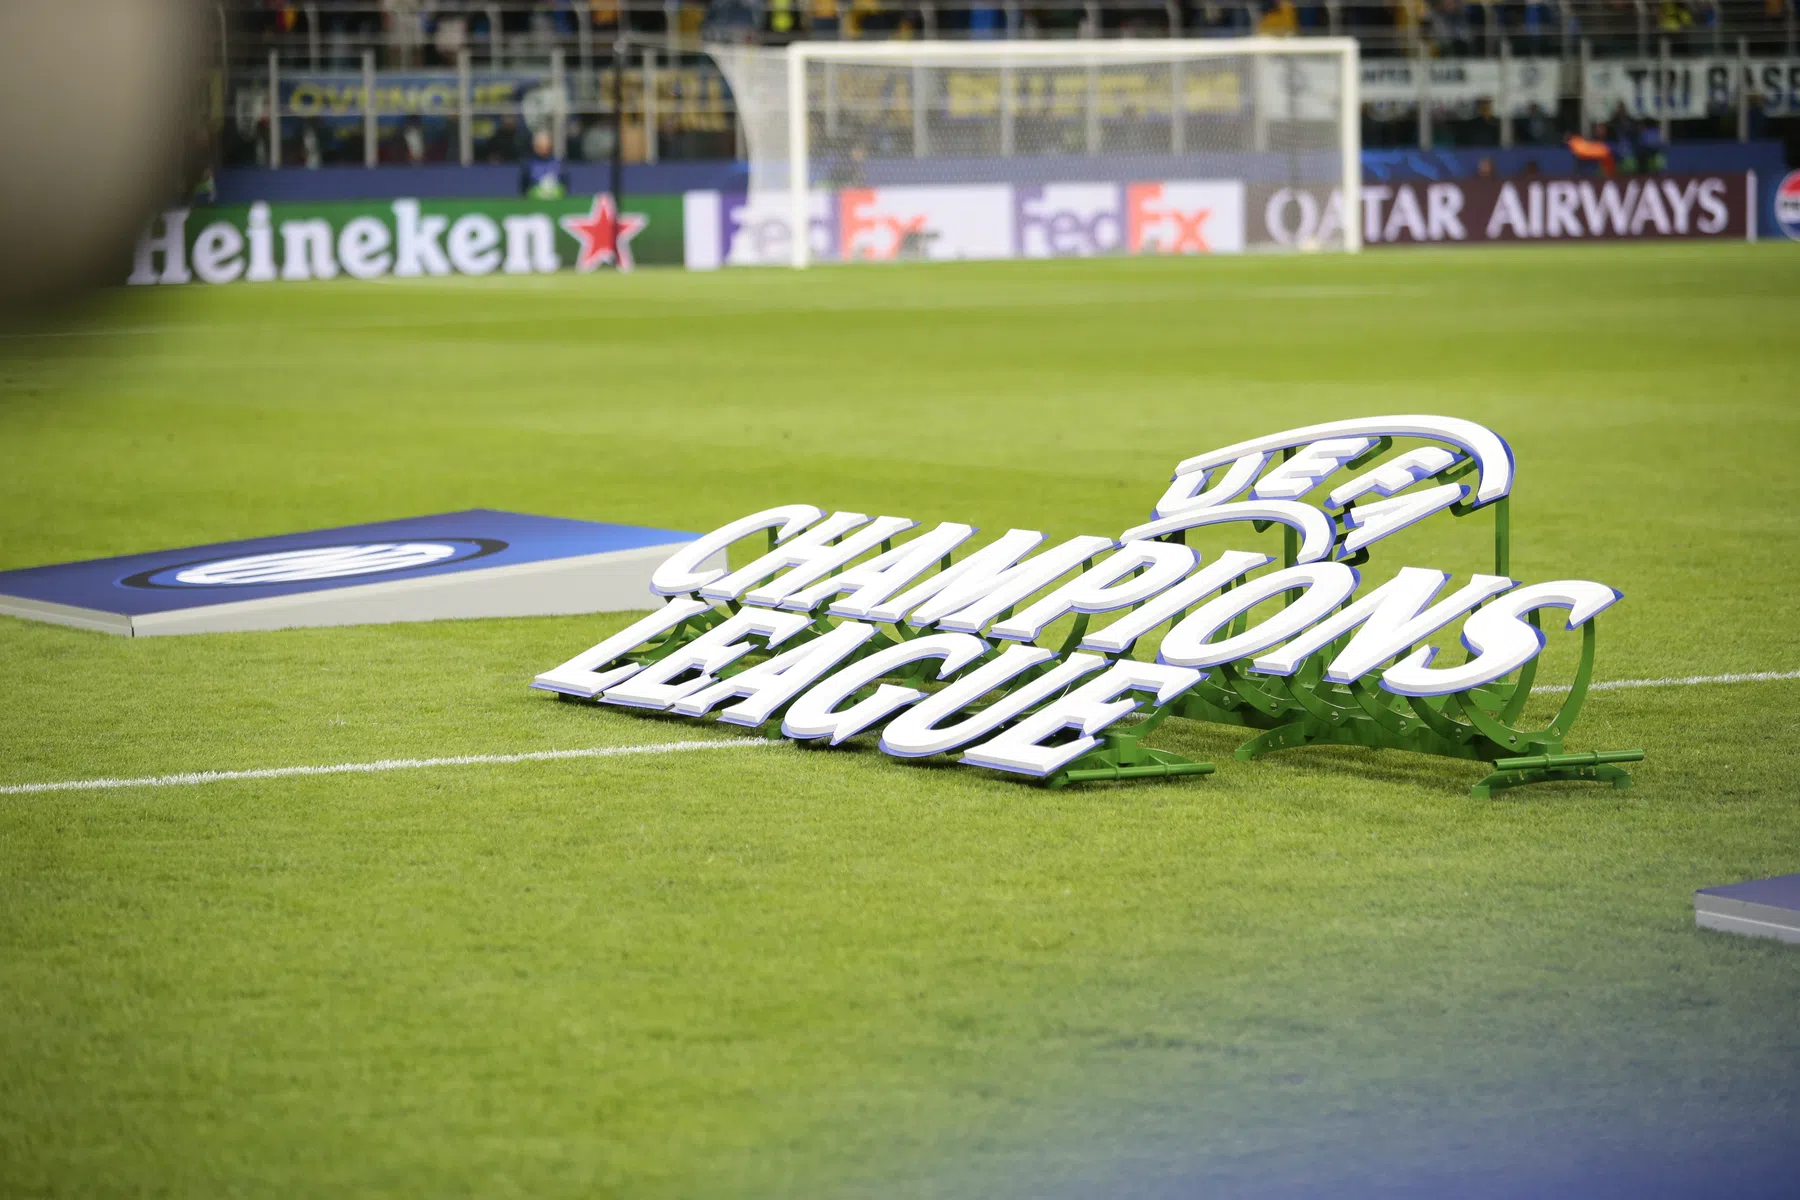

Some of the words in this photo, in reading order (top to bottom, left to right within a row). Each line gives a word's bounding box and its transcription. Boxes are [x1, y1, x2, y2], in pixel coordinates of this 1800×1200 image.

[127, 200, 562, 285] Heineken
[1013, 182, 1212, 256] FedEx
[1264, 182, 1467, 245] QATAR
[1486, 176, 1729, 240] AIRWAYS
[1150, 436, 1471, 562] UEFA
[649, 503, 1623, 698] CHAMPIONS
[529, 597, 1210, 777] LEAGUE
